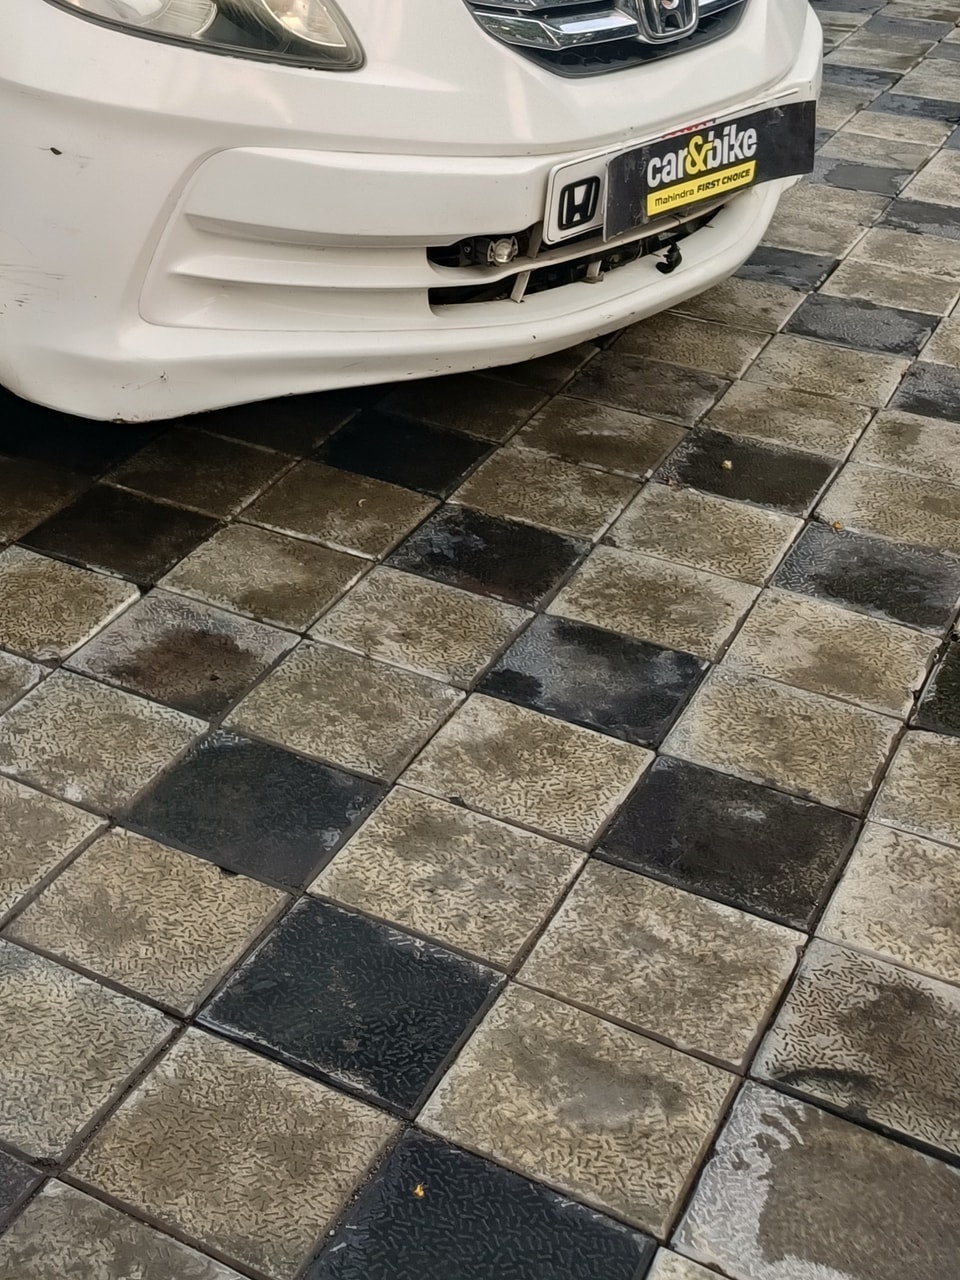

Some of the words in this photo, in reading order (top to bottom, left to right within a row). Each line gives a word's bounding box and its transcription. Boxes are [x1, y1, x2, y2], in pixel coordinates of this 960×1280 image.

[647, 124, 757, 188] car&bike
[655, 188, 694, 207] Mahindra
[697, 178, 721, 193] FIRST
[721, 168, 751, 185] CHOICE
